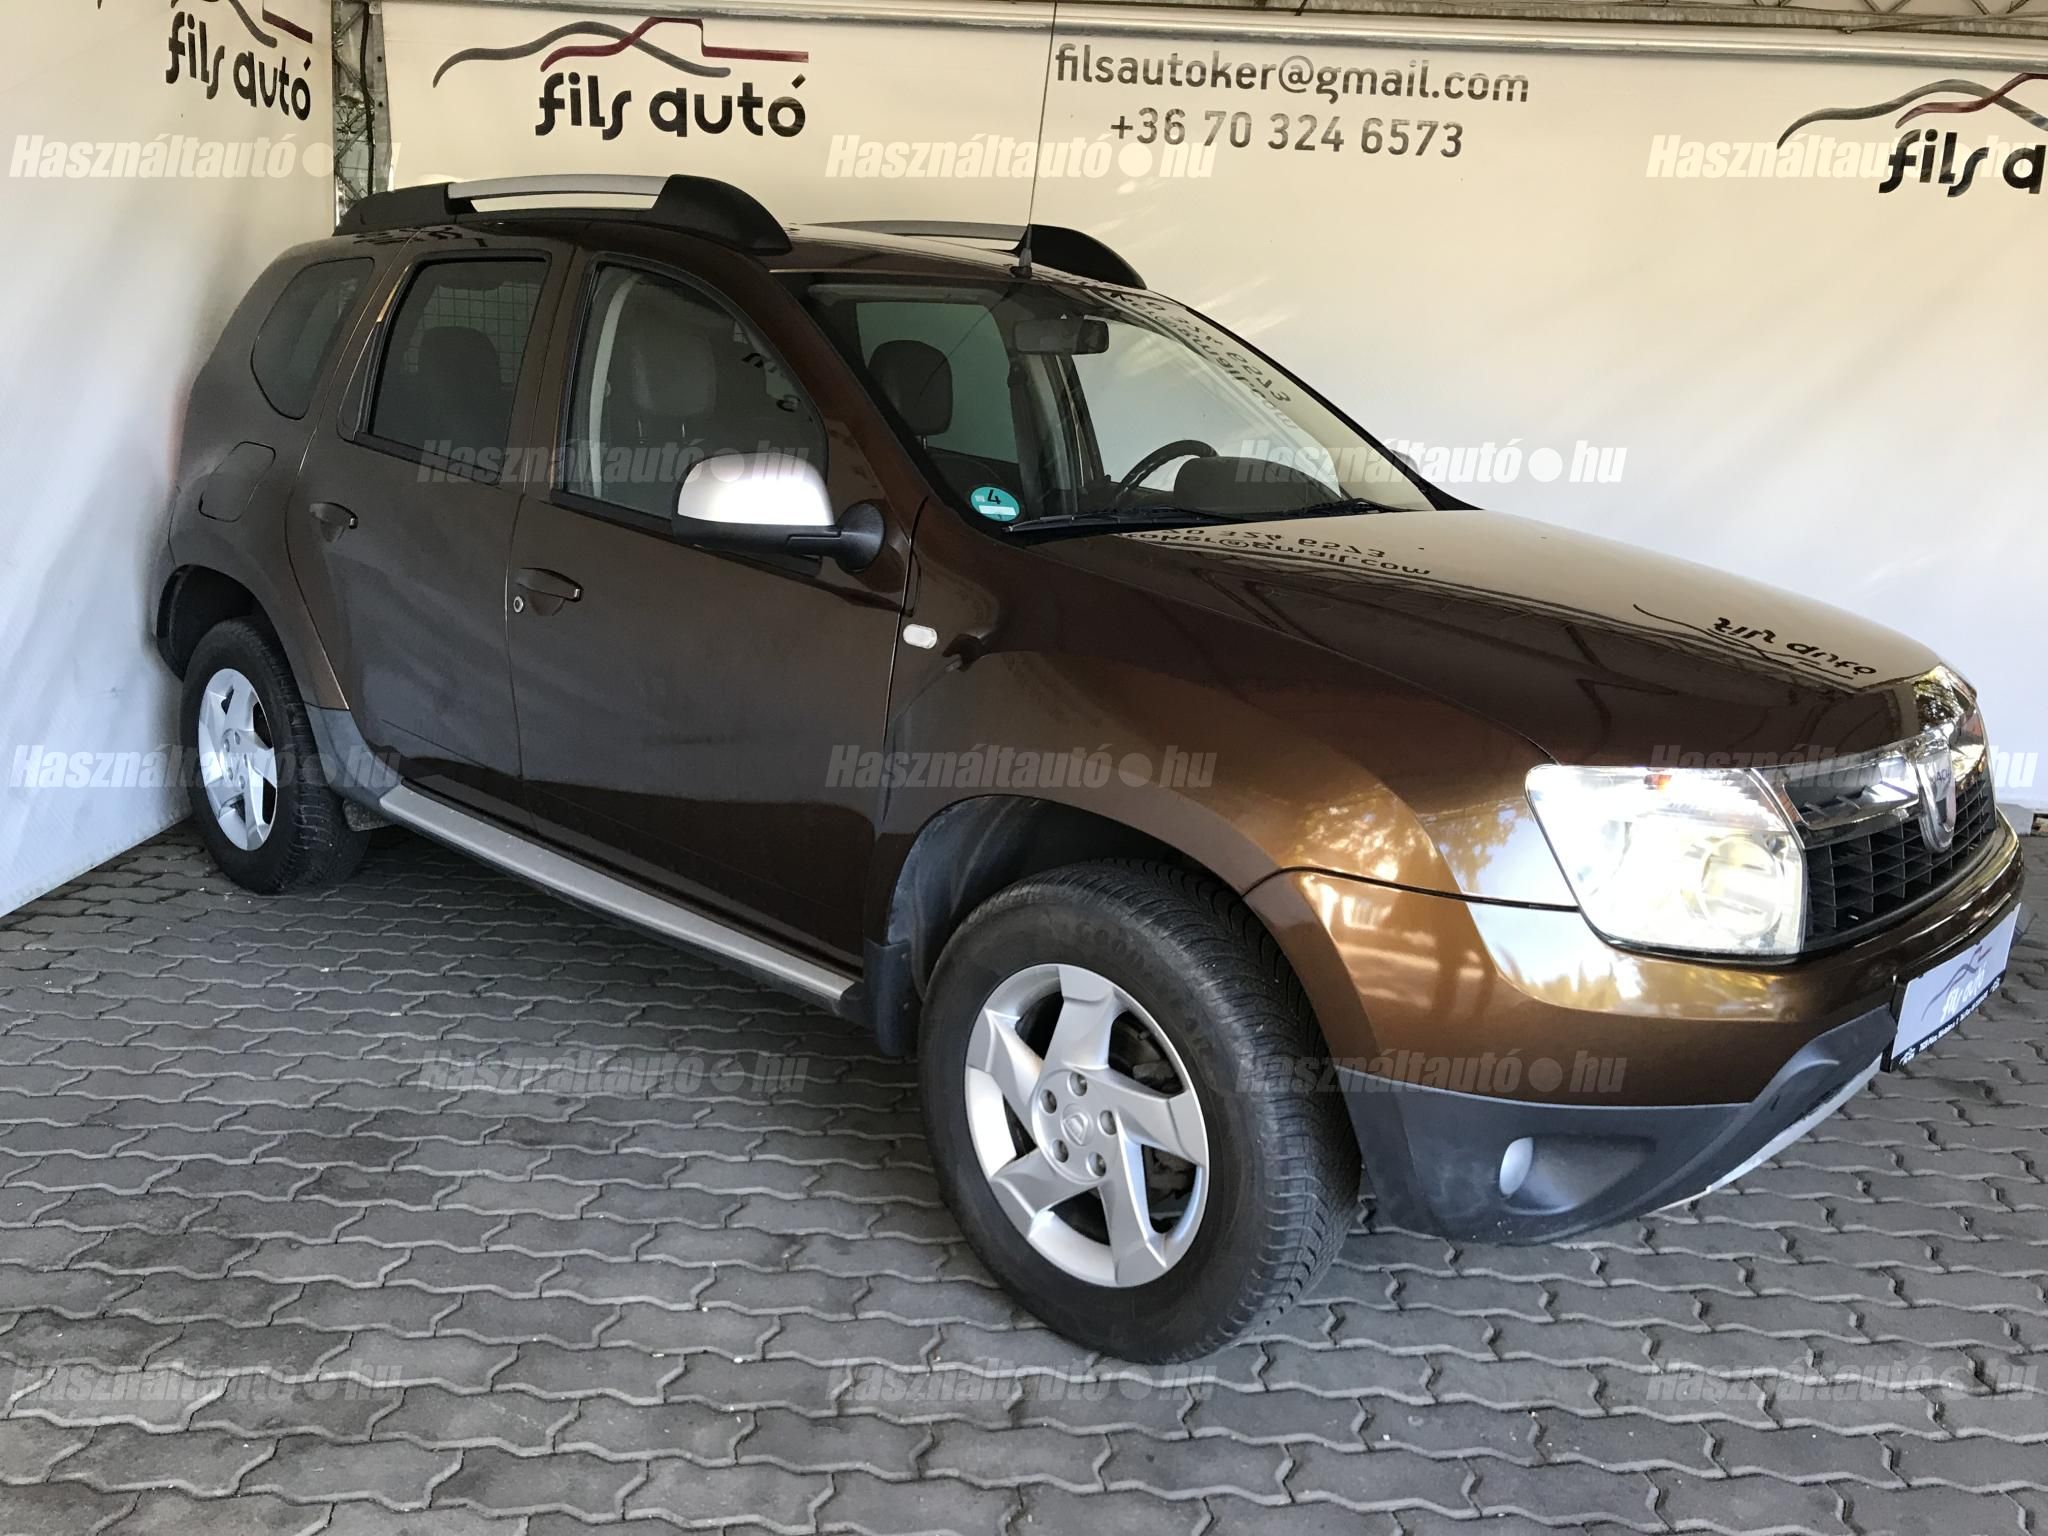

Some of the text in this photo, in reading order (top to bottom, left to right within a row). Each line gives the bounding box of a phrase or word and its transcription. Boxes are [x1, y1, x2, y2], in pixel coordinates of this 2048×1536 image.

[166, 11, 311, 121] fils autó
[1055, 44, 1528, 104] filsautoker@gmail.com
[535, 72, 806, 141] fils autó
[1111, 108, 1464, 158] +36 70 324 6573
[1879, 128, 1990, 197] fils
[987, 489, 1001, 505] 4
